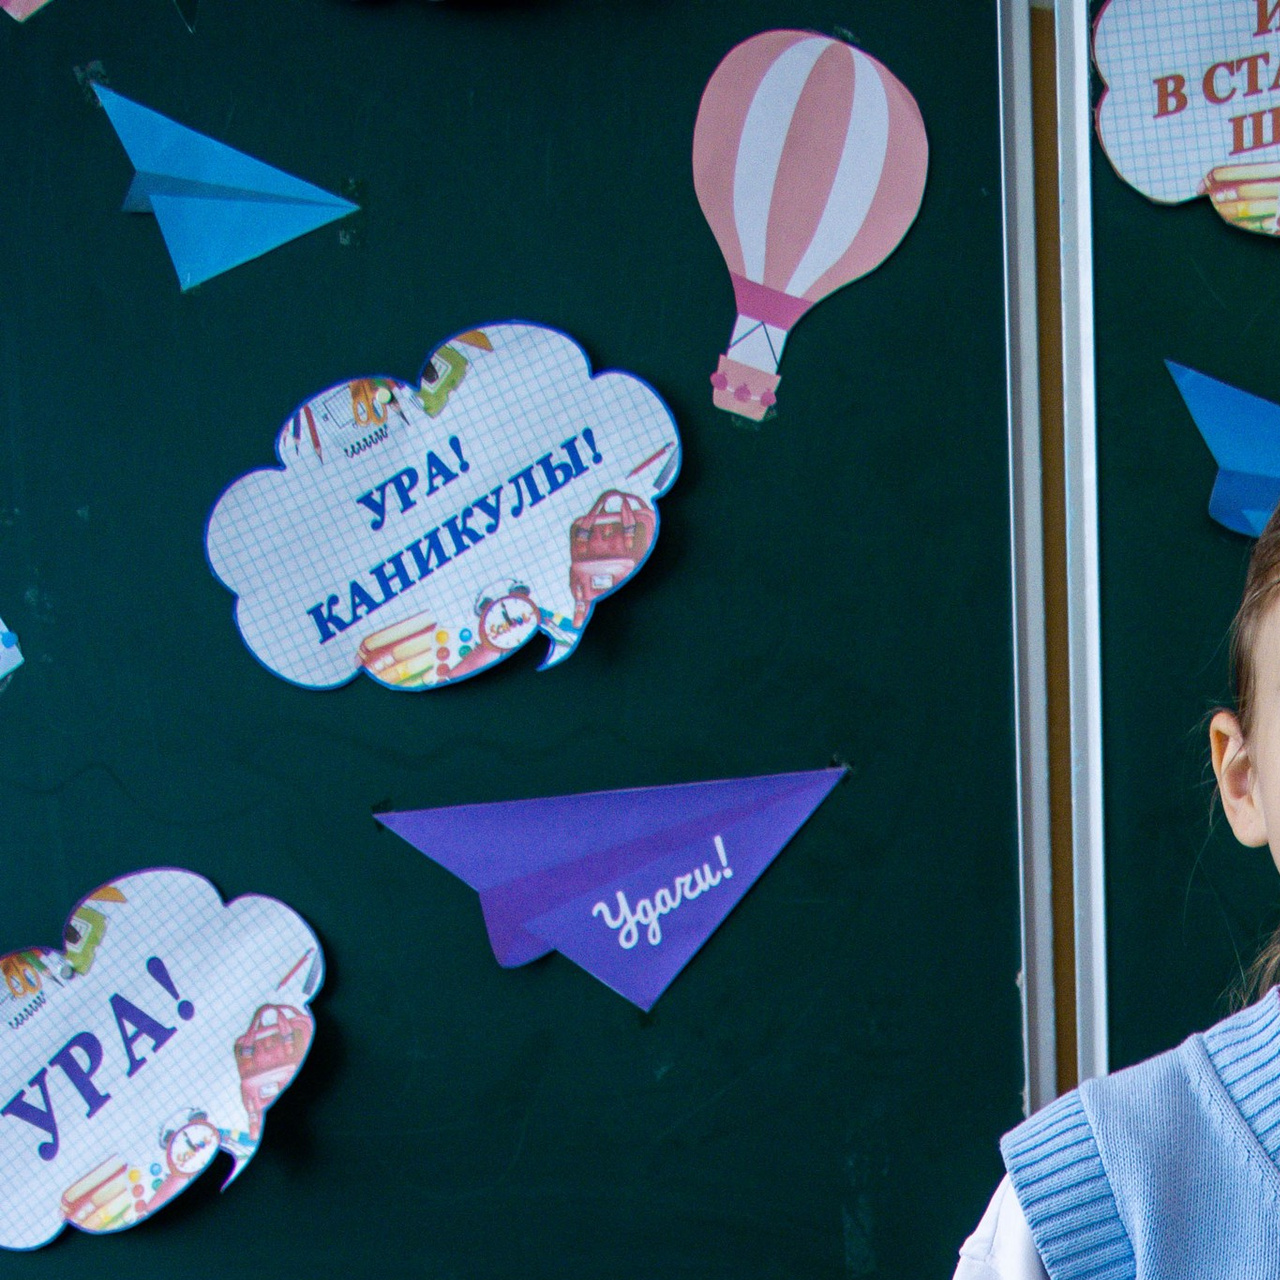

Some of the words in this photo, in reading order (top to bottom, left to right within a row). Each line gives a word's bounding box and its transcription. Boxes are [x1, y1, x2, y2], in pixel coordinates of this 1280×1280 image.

[1153, 73, 1189, 120] В
[305, 427, 606, 646] КАНИКУЛЫ!
[356, 435, 471, 533] УРА!
[592, 834, 735, 950] Удачи!
[1, 955, 196, 1161] УРА!
